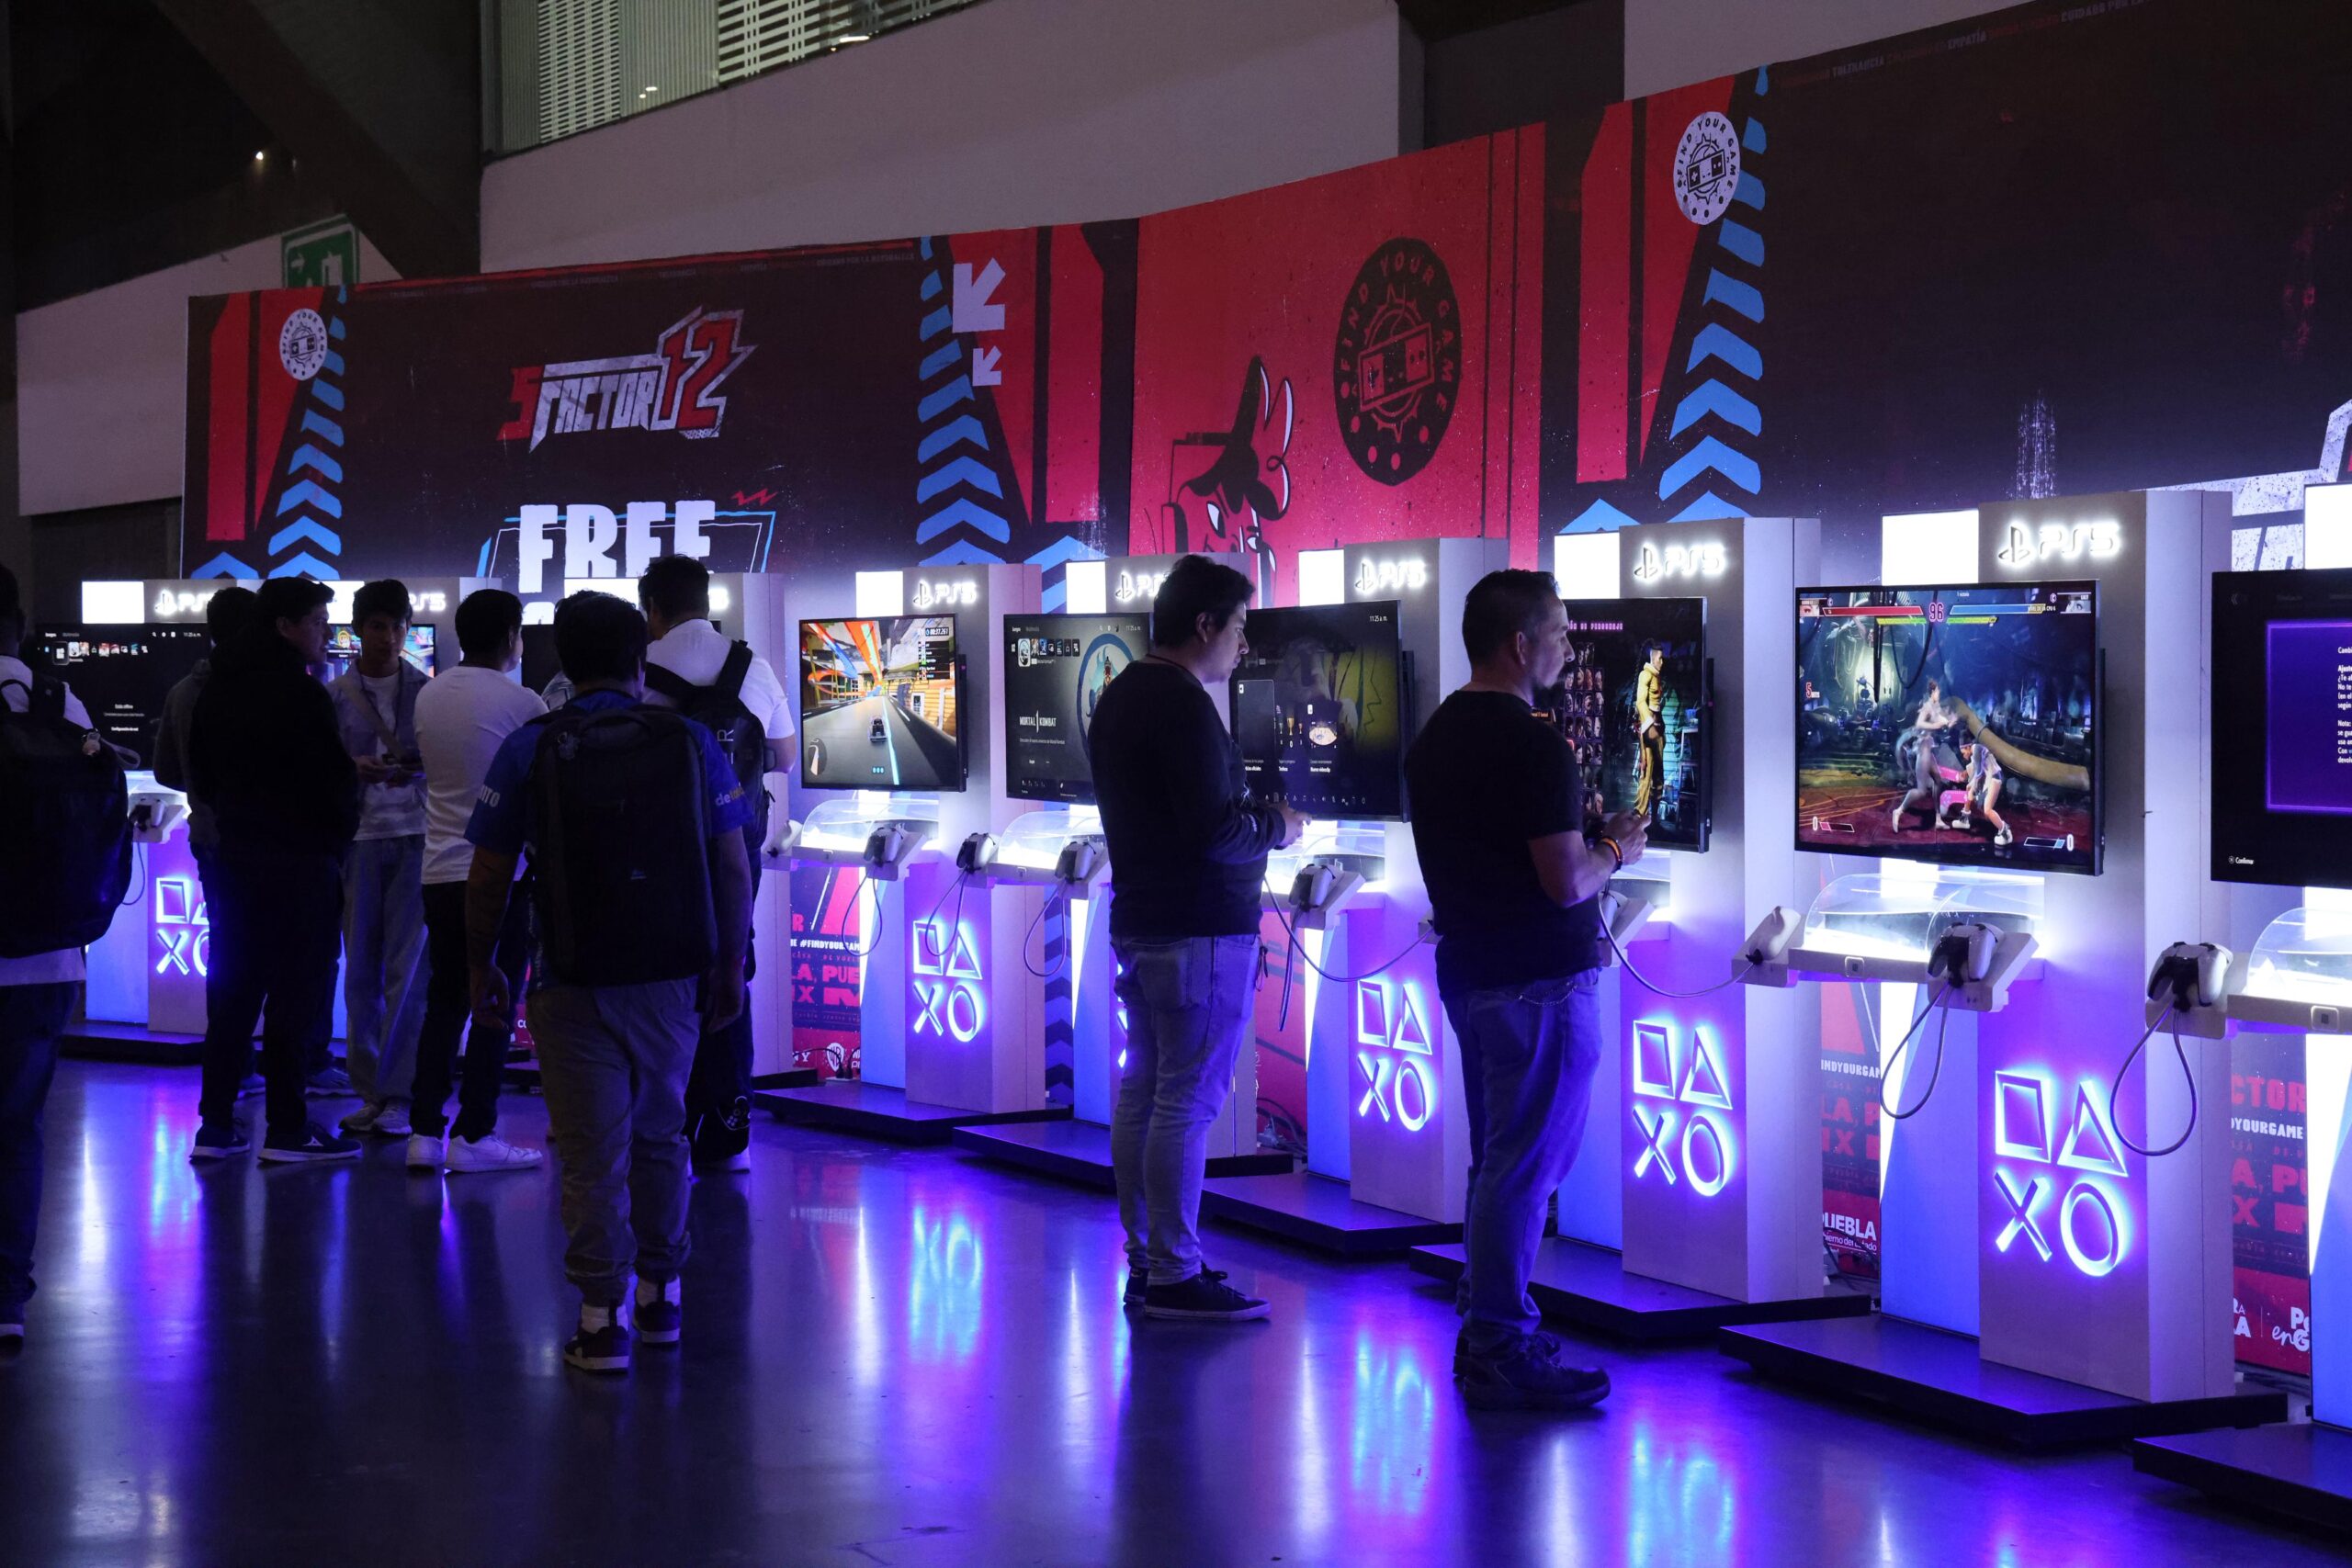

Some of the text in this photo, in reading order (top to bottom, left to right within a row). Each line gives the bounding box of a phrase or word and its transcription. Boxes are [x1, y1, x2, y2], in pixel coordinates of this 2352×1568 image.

[518, 501, 716, 594] FREE
[2039, 522, 2121, 559] PS5
[1378, 560, 1426, 589] PS5
[1664, 544, 1726, 577] PS5
[934, 582, 978, 605] PS5
[1136, 574, 1166, 598] PS
[177, 592, 213, 613] PS
[1928, 602, 1944, 623] 96
[1822, 1212, 1877, 1241] UEBLA
